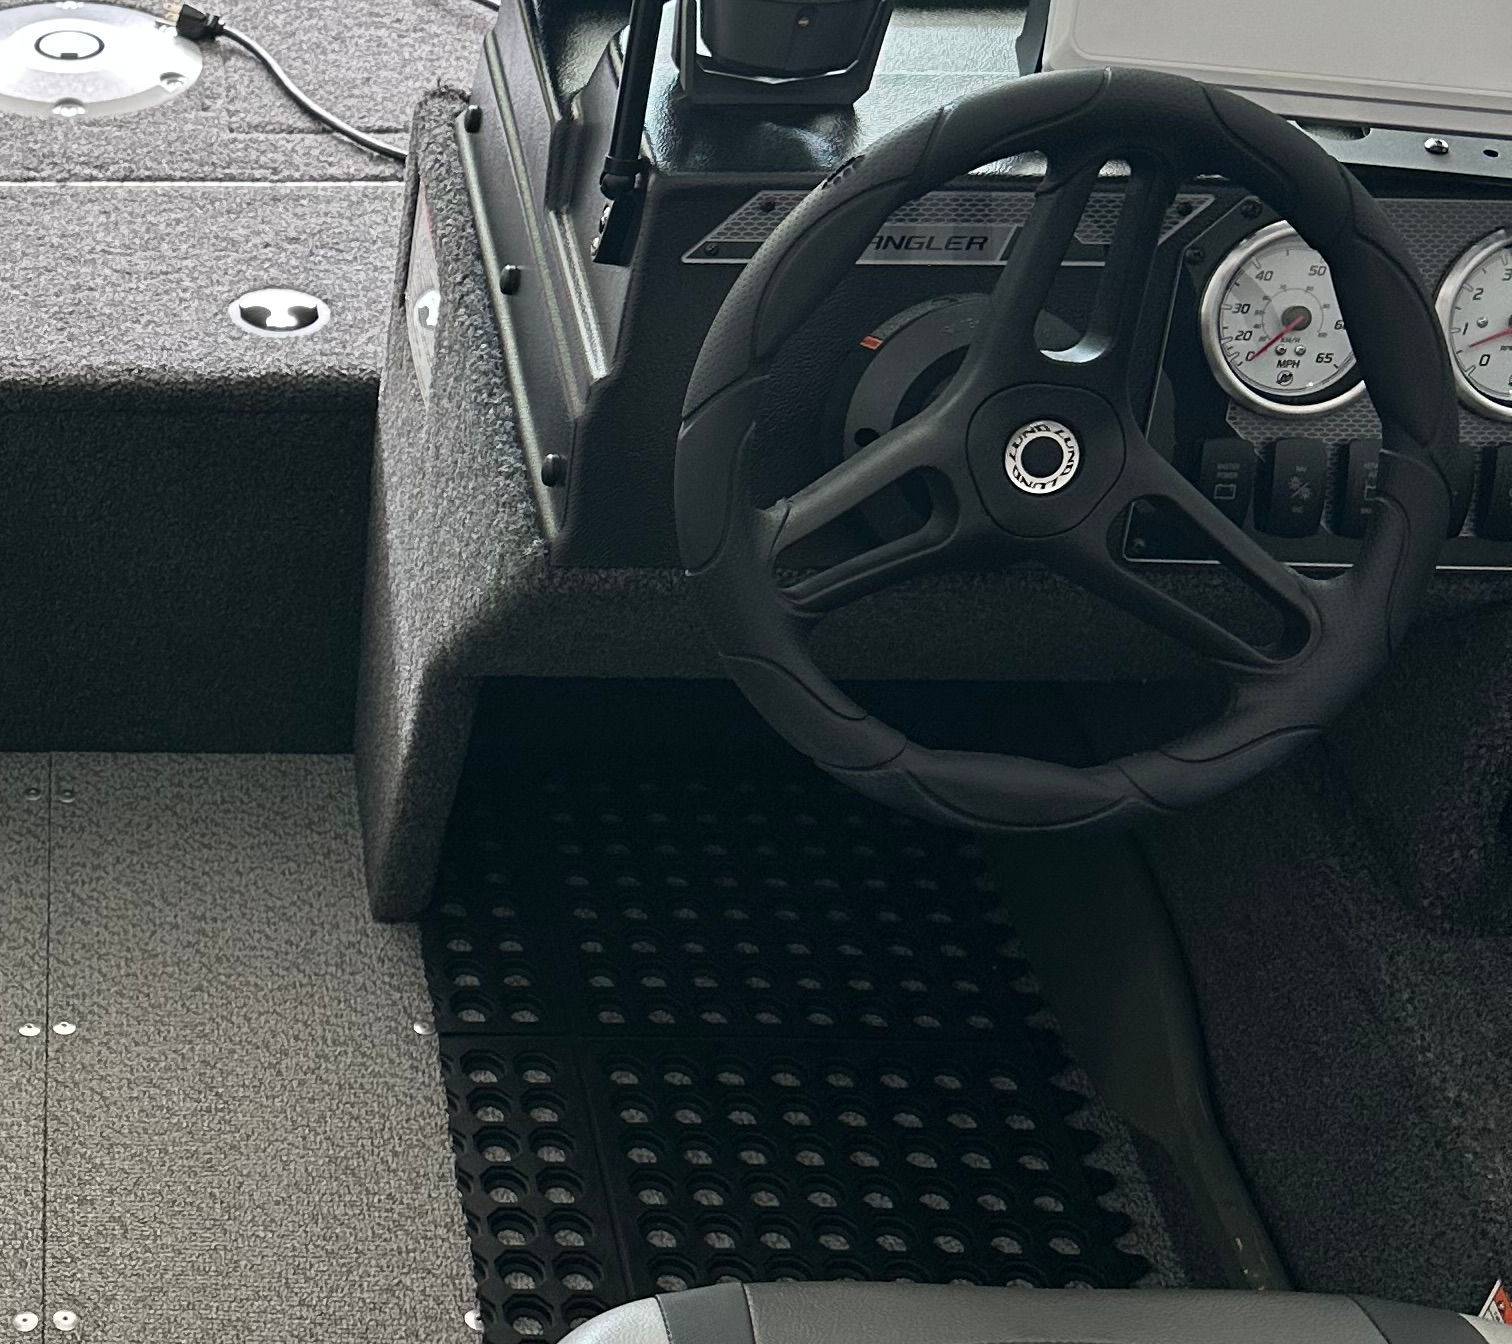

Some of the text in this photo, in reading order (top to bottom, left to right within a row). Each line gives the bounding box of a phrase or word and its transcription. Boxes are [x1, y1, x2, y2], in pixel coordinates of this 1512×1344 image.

[1255, 269, 1274, 282] 40
[1308, 264, 1328, 277] 50
[1472, 287, 1484, 301] 2
[1232, 303, 1251, 315] 30
[1234, 330, 1253, 341] 20
[1462, 322, 1469, 336] 1
[1276, 359, 1301, 369] MPH
[1315, 352, 1334, 364] 65
[1479, 354, 1491, 367] 0
[1009, 424, 1051, 462] LUND
[1054, 429, 1075, 477] LUND
